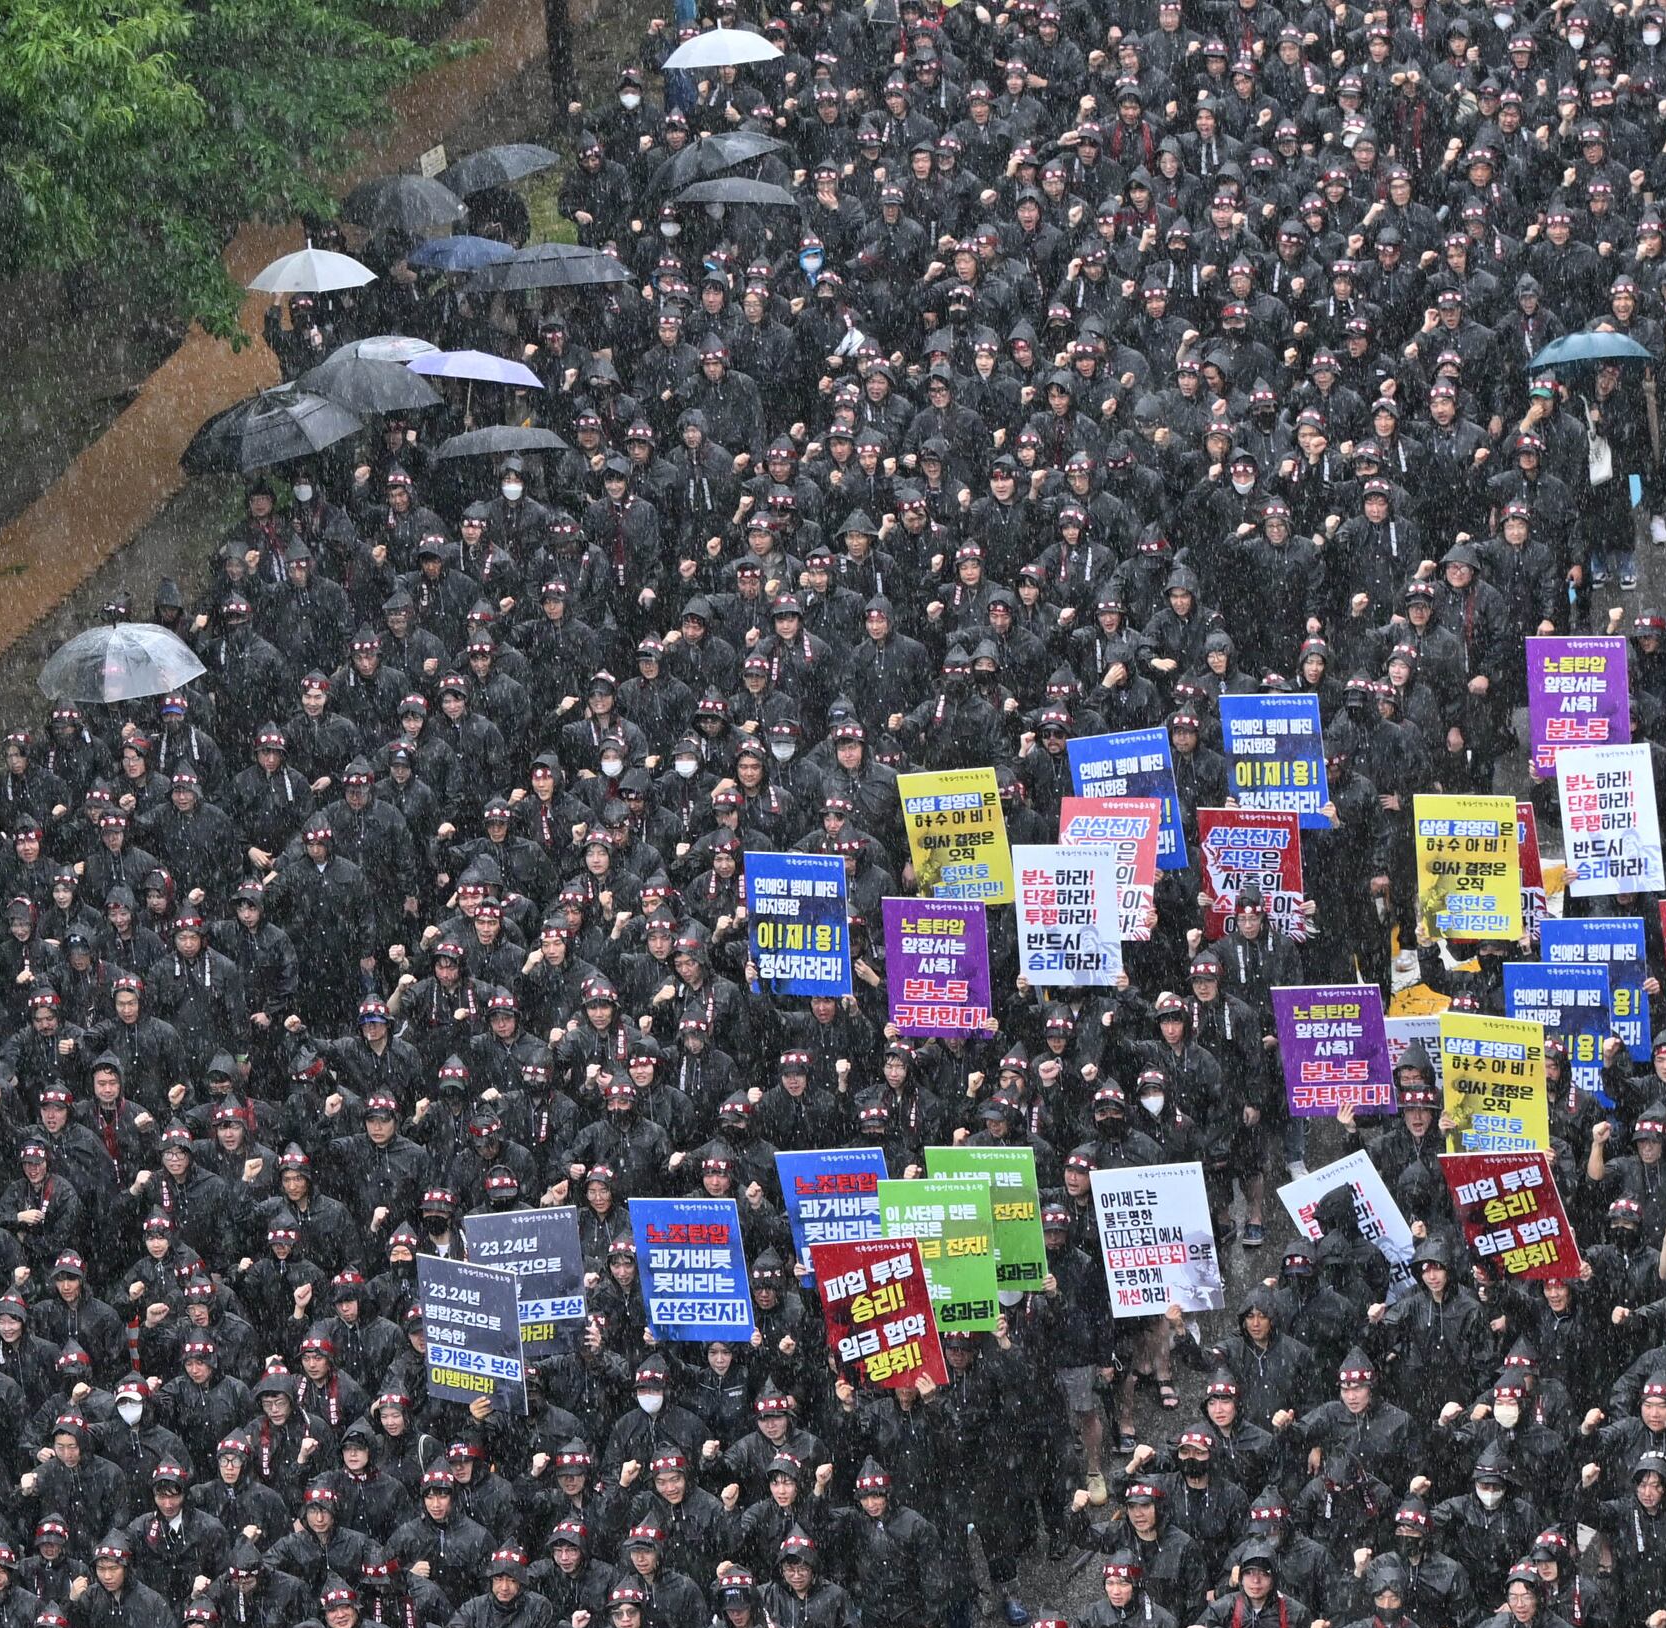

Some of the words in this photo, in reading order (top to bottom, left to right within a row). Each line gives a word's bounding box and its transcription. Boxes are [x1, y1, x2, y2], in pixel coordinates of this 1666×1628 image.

[1543, 657, 1606, 672] 노동탄압
[1544, 677, 1607, 693] 앞장서는
[1560, 696, 1597, 712] 사측!
[1231, 720, 1263, 735] 연예인
[1266, 719, 1287, 734] 병에
[1290, 719, 1312, 733] 빠진
[1546, 718, 1609, 741] 분노로
[1232, 739, 1276, 754] 바지회장
[1566, 770, 1632, 791] 분노하라!
[1567, 792, 1634, 811] 단결하라!
[1420, 821, 1450, 836] 삼성
[1452, 820, 1497, 835] 경영진
[1500, 822, 1513, 836] 은
[1570, 812, 1637, 832] 투쟁하라!
[1574, 838, 1623, 859] 반드시
[1021, 869, 1094, 886] 분노하라!
[1433, 862, 1461, 876] 의사
[1465, 862, 1506, 876] 결정은
[1577, 858, 1649, 881] 승리하라!
[754, 878, 787, 896] 연예인
[790, 878, 813, 896] 병에
[815, 881, 837, 898] 빠진
[1456, 877, 1484, 891] 오직
[1024, 888, 1095, 905] 단결하라!
[1445, 894, 1496, 912] 정현호
[755, 898, 800, 915] 바지회장
[901, 918, 965, 935] 노동탄압
[1024, 909, 1097, 925] 투쟁하라!
[1436, 914, 1510, 931] 부회장만!
[901, 938, 966, 955] 앞장서는
[1027, 934, 1081, 951] 반드시
[759, 955, 842, 981] 정신차려라!
[918, 959, 956, 975] 사측!
[1028, 952, 1107, 971] 승리하라!
[904, 980, 967, 1002] 분노로
[894, 1004, 987, 1028] 규탄한다!
[1292, 1003, 1361, 1020] 노동탄압
[1295, 1023, 1363, 1038] 앞장서는
[1314, 1039, 1354, 1056] 사측!
[1301, 1060, 1368, 1081] 분노로
[1292, 1084, 1390, 1108] 규탄한다!
[1456, 1180, 1498, 1205] 파업
[1502, 1165, 1543, 1191] 투쟁
[1101, 1190, 1158, 1210] OPI제도는
[1484, 1192, 1538, 1225] 승리!
[1103, 1210, 1154, 1229] 불투명한
[646, 1224, 731, 1244] 노조탄압
[1106, 1229, 1156, 1248] EVA방식
[1159, 1227, 1183, 1243] 에서
[1474, 1228, 1515, 1256] 임금
[1518, 1217, 1559, 1245] 협약
[650, 1249, 732, 1269] 과거버릇
[1108, 1244, 1186, 1268] 영업이익방식
[1188, 1243, 1212, 1262] 으로
[1502, 1243, 1559, 1274] 쟁취!
[653, 1273, 735, 1293] 못버리는
[823, 1272, 867, 1302] 파업
[870, 1254, 914, 1288] 투쟁
[1114, 1268, 1163, 1286] 투명하게
[850, 1284, 905, 1323] 승리!
[1116, 1287, 1171, 1306] 개선하라!
[655, 1302, 746, 1323] 삼성전자!
[838, 1328, 881, 1363] 임금
[883, 1315, 926, 1345] 협약
[864, 1347, 923, 1382] 쟁취!
